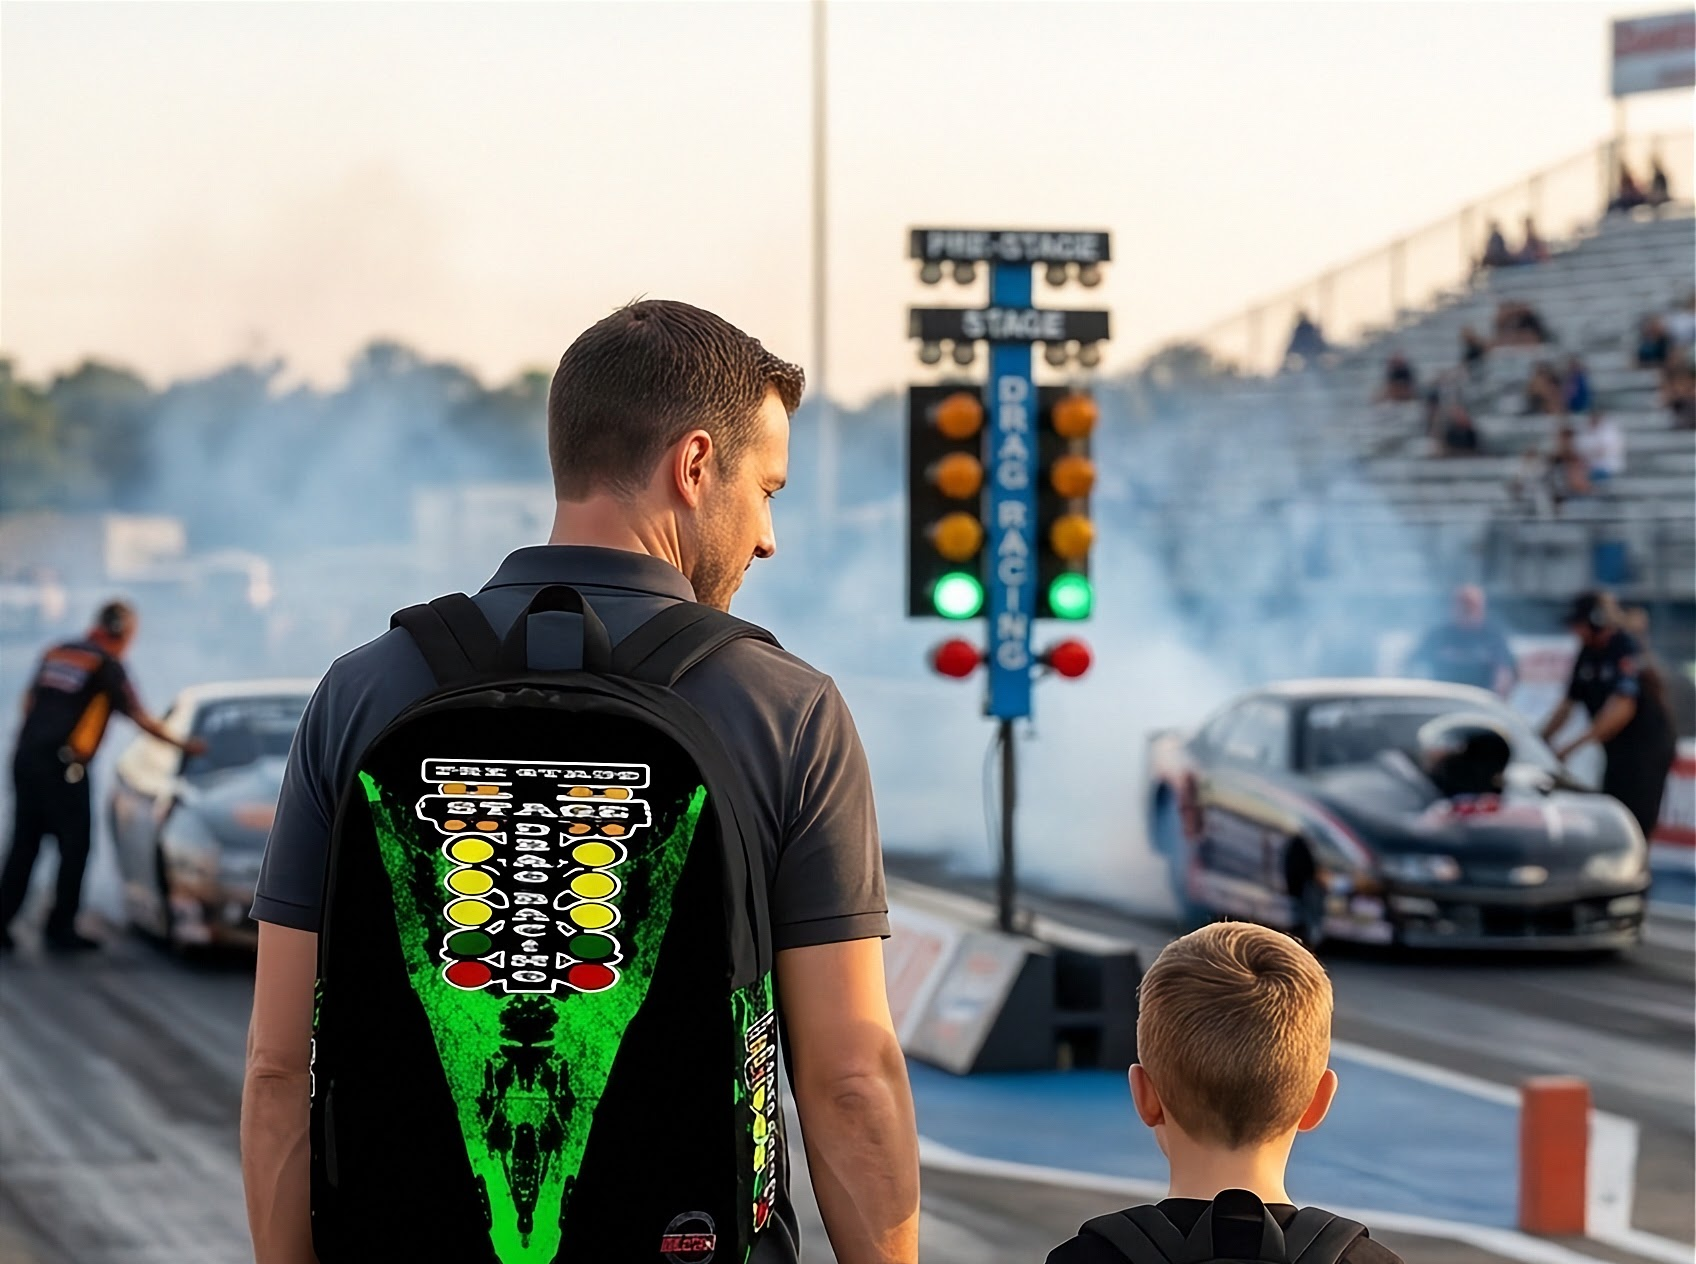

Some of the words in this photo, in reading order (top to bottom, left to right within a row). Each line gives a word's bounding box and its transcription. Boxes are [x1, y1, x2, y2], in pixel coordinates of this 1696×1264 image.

[926, 233, 1102, 260] PRE-STAGE
[962, 311, 1066, 338] STAGE
[997, 376, 1029, 488] DRAG
[997, 501, 1029, 670] RACING
